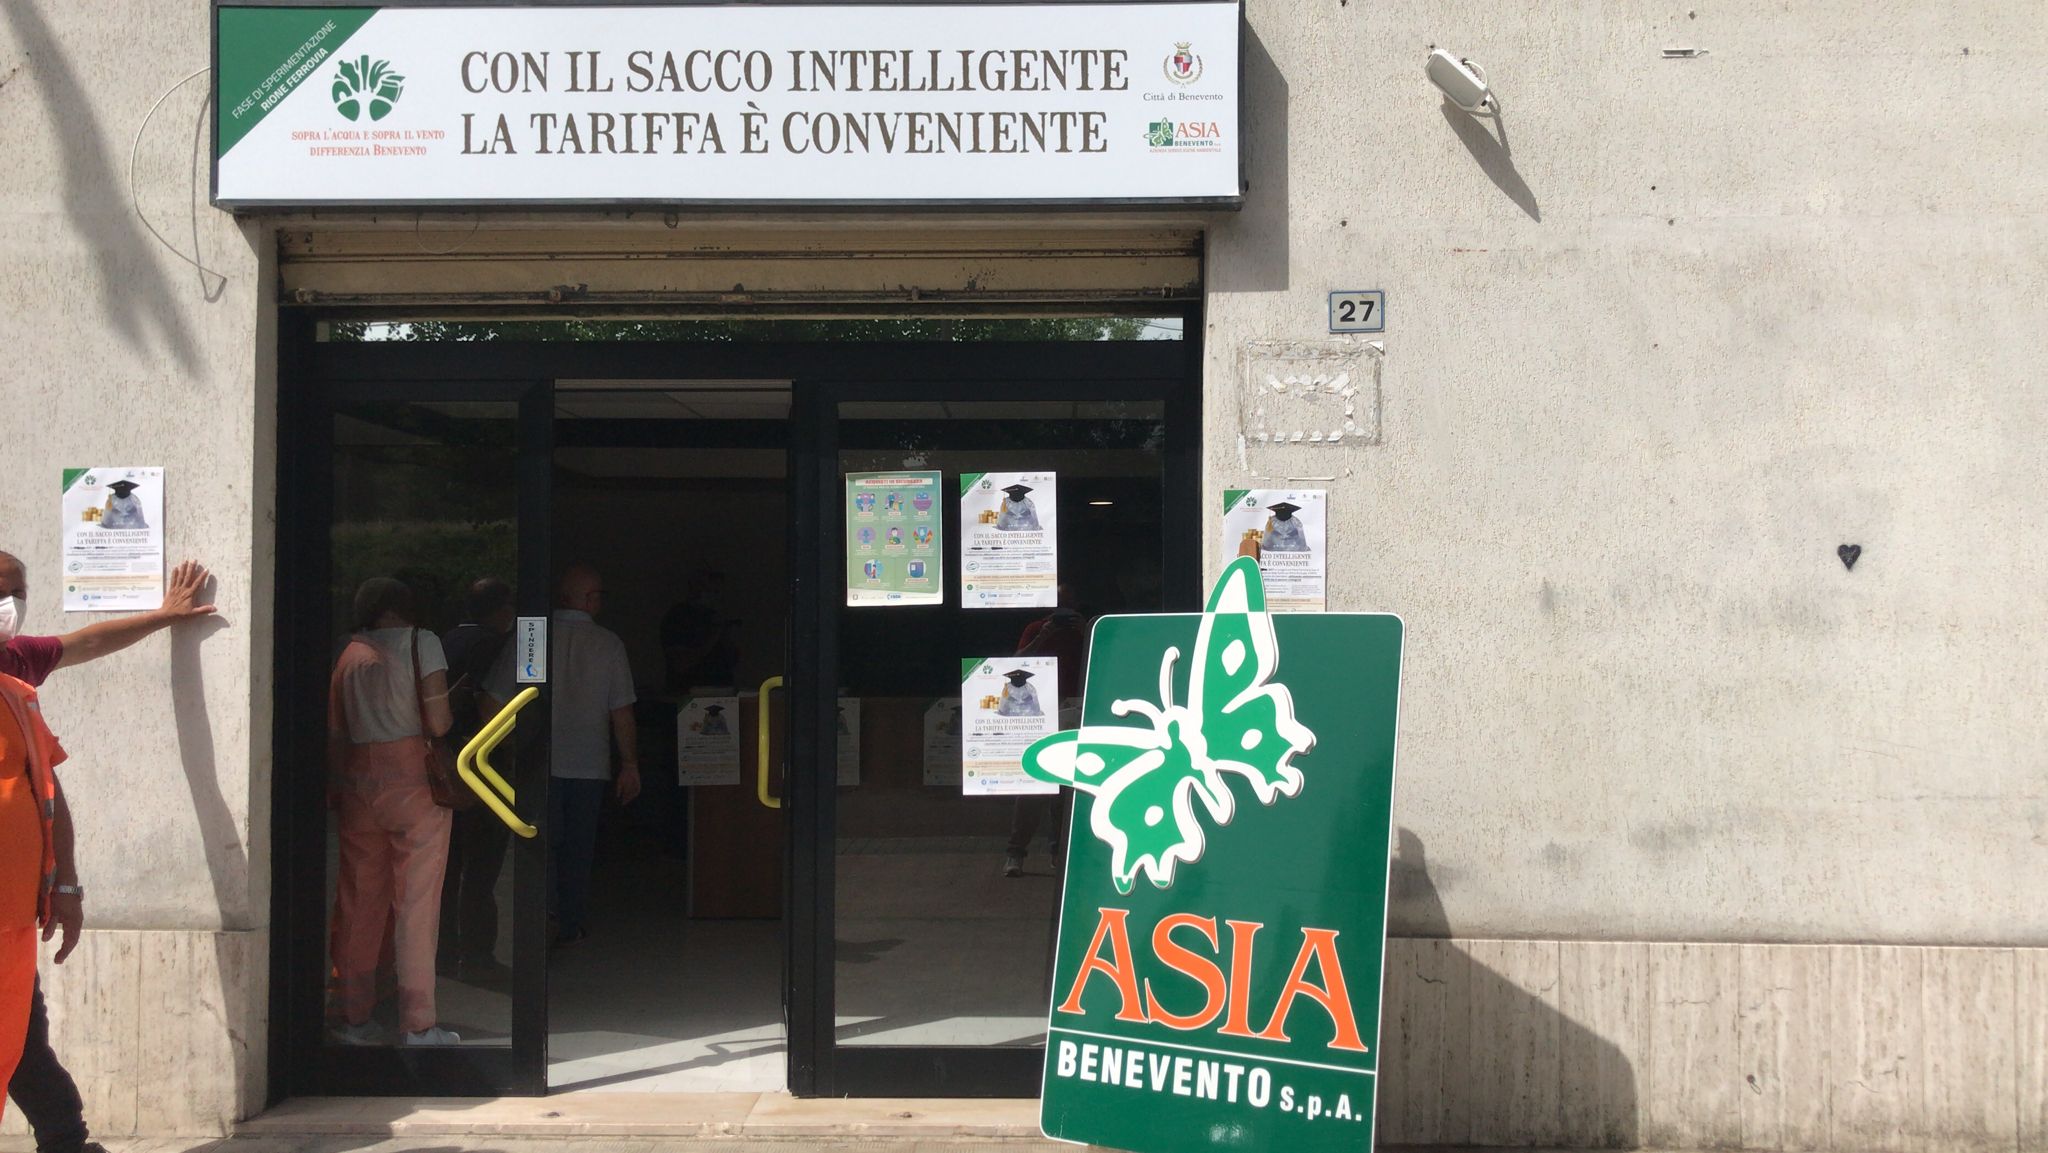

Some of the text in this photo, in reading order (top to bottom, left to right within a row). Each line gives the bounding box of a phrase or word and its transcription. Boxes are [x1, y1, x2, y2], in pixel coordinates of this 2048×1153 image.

[231, 19, 337, 119] FASE DI SPERIMENTAZIONE
[260, 47, 329, 111] RIONE FERROVIA
[461, 49, 1129, 93] CON IL SACCO INTELLIGENTE
[1143, 92, 1224, 101] Città di Benevento
[291, 131, 320, 140] SOPRA
[372, 131, 400, 140] SOPRA
[416, 130, 445, 139] VENTO
[460, 100, 1108, 155] LA TARIFFA È CONVENIENTE
[1175, 122, 1220, 138] ASIA
[310, 146, 370, 156] DIFFERENZIA
[1338, 300, 1375, 322] 27
[1057, 907, 1369, 1053] ASIA
[1057, 1040, 1363, 1121] BENEVENTO S.p.A.
